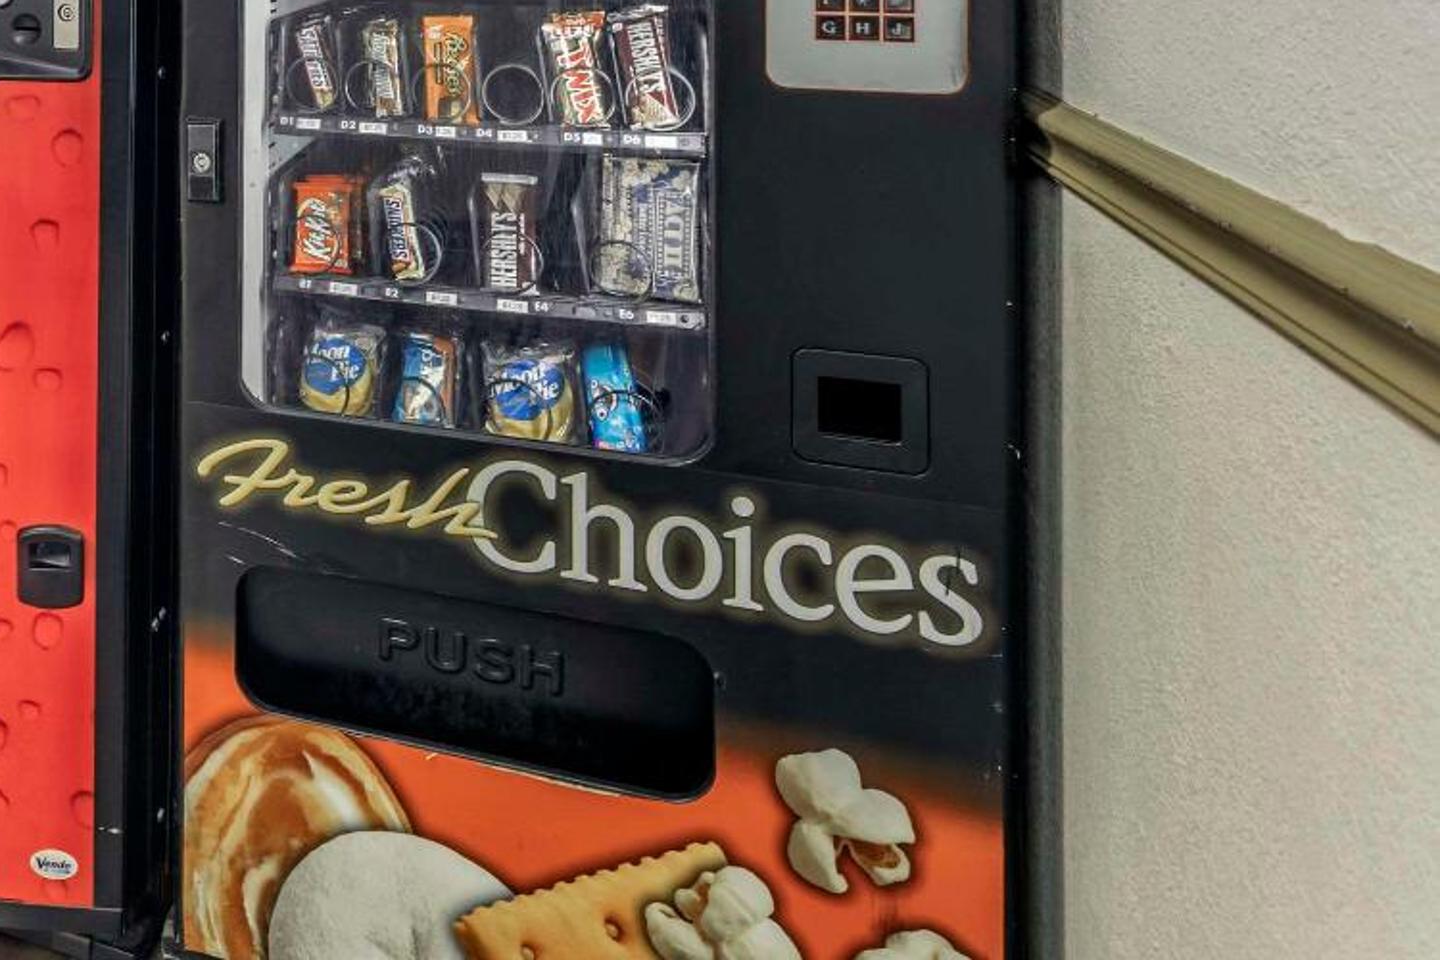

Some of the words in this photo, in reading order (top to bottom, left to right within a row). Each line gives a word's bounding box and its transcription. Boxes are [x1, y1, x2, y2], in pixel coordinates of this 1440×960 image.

[822, 20, 837, 34] G
[856, 22, 870, 34] H
[341, 119, 356, 129] D2
[417, 124, 433, 135] D3
[490, 211, 518, 288] HERSHEY'S
[197, 438, 497, 540] Fresh
[466, 459, 984, 647] Choices
[377, 616, 565, 697] PUSH
